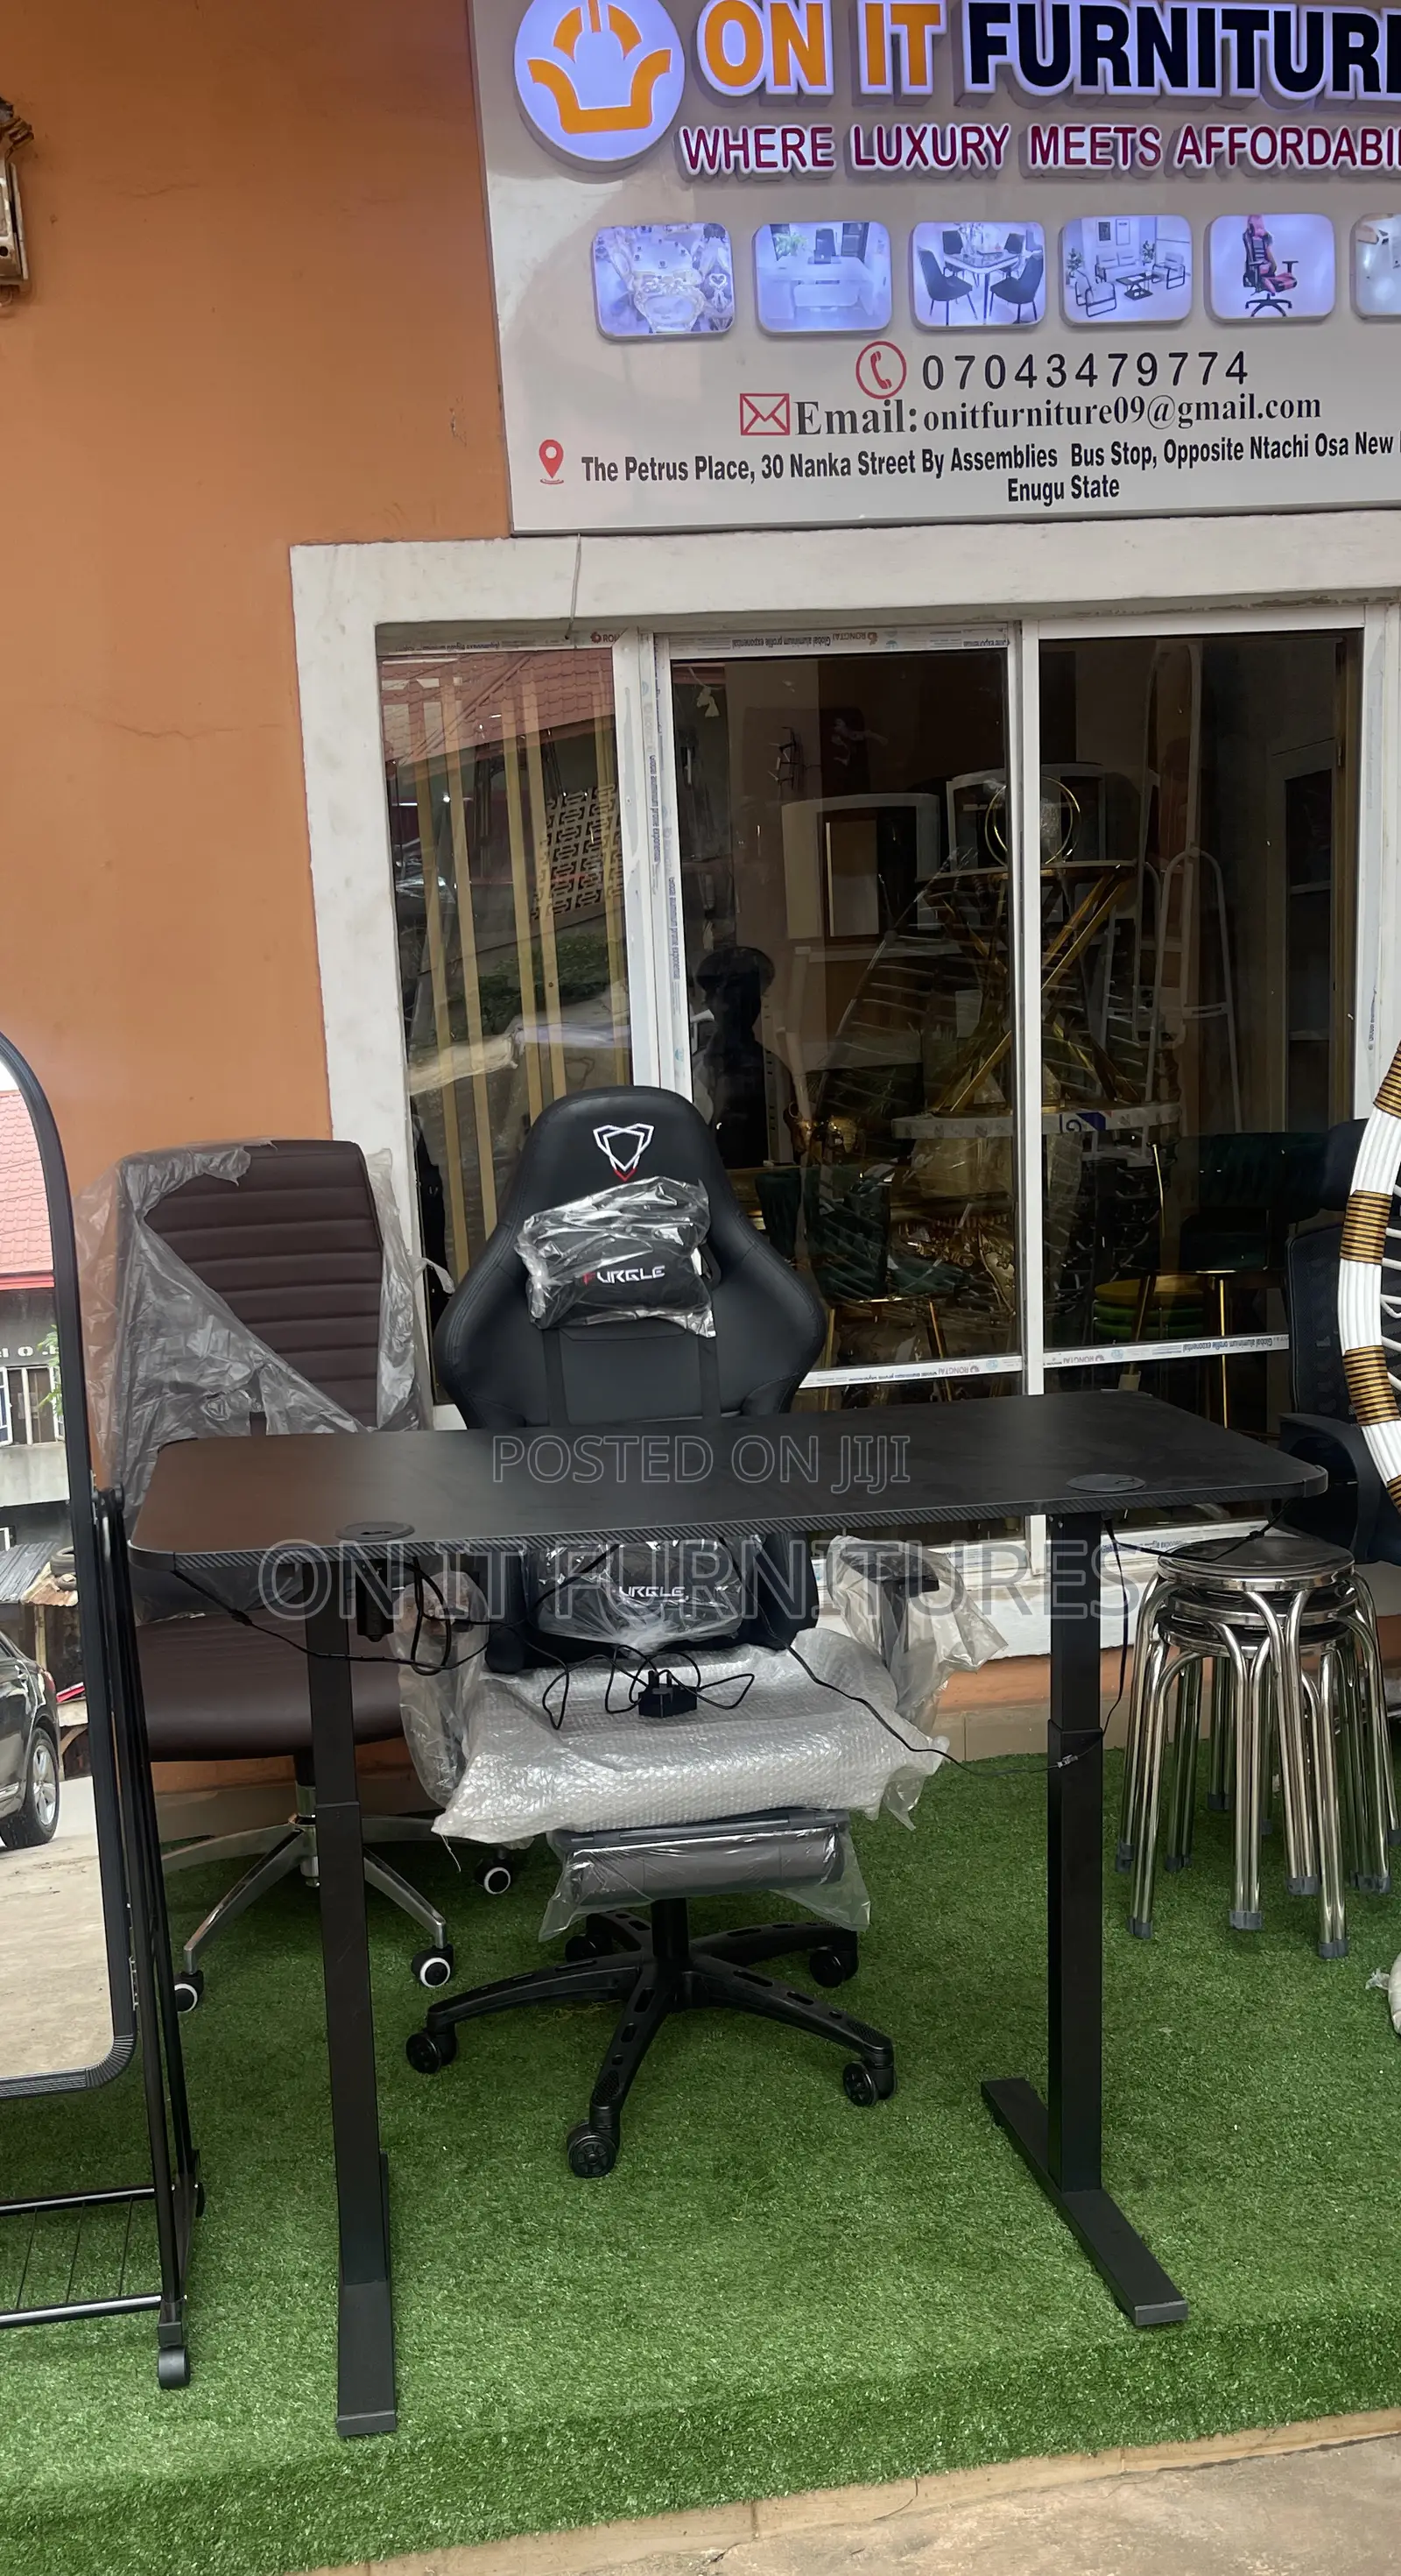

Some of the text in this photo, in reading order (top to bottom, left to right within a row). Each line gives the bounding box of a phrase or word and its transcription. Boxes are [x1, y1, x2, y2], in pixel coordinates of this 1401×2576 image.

[700, 0, 829, 91] ON
[863, 1, 944, 89] IT
[680, 125, 834, 171] WHERE
[853, 124, 1010, 169] LUXURY
[1031, 124, 1161, 167] MEETS
[922, 350, 1249, 392] 07043479774
[794, 392, 1321, 436] Email: onitfurniture09@gmail.com
[581, 455, 618, 483] The
[625, 455, 688, 482] Petrus
[695, 454, 755, 484] Place,
[761, 453, 784, 479] 30
[791, 452, 851, 478] Nanka
[858, 449, 916, 476] Street
[922, 448, 944, 478] By
[950, 443, 1058, 472] Assemblies
[1071, 442, 1105, 468] Bus
[1111, 439, 1158, 470] Stop,
[1164, 438, 1243, 469] Opposite
[1250, 434, 1309, 461] Ntachi
[1315, 433, 1349, 456] Osa
[1355, 431, 1394, 455] New
[1008, 474, 1120, 506] Enugu State
[618, 1585, 686, 1598] URGLE
